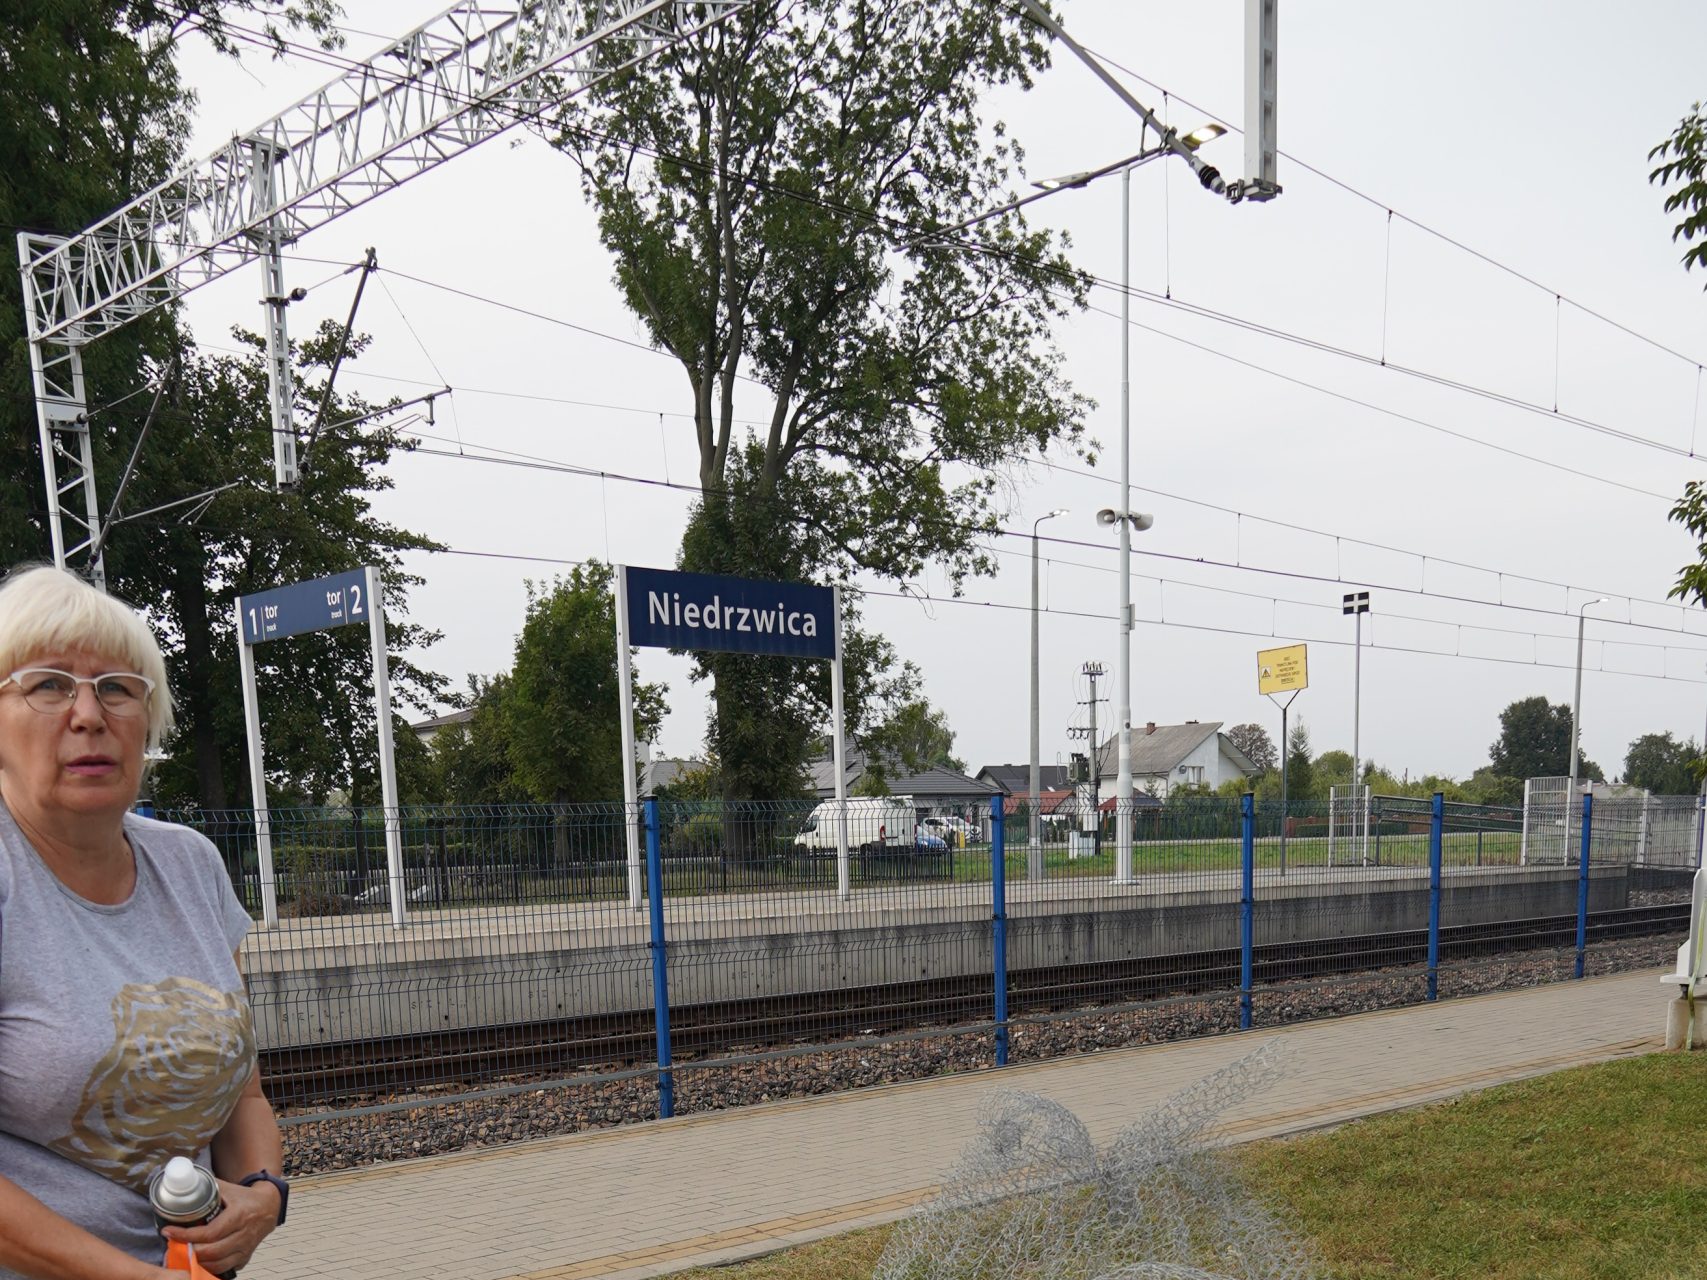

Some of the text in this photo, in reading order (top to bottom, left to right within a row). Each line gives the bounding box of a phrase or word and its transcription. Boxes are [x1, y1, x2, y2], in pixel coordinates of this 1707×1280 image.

[326, 585, 362, 614] tor 2
[648, 591, 817, 637] Niedrzwica
[249, 605, 278, 636] 1 tor
